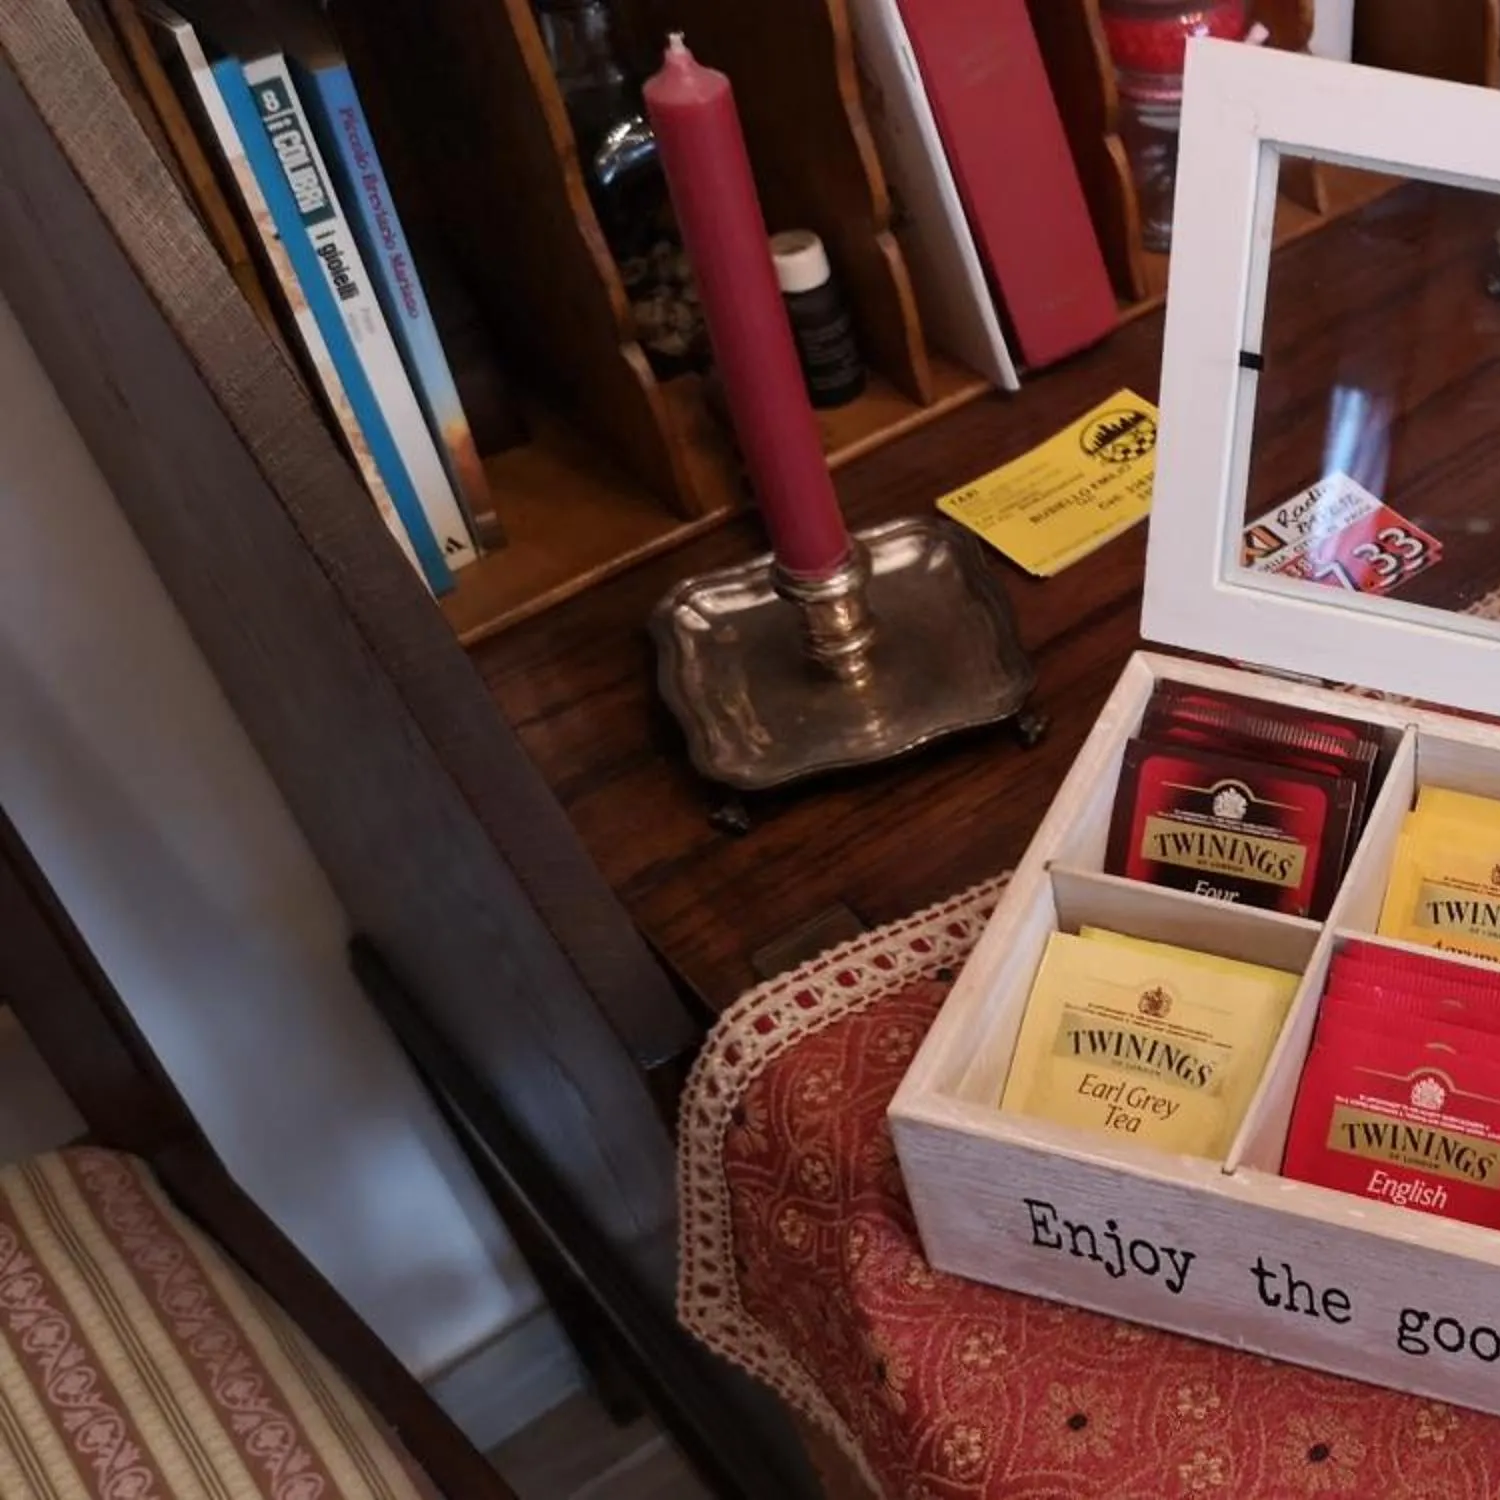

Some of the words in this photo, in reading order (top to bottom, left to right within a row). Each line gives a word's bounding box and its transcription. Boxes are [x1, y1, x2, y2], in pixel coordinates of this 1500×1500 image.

[339, 107, 368, 170] Piccolo
[362, 171, 397, 251] Breviario
[390, 251, 420, 320] Mariano
[317, 242, 360, 301] gioielli
[1154, 831, 1293, 881] TWININGS
[1067, 1028, 1213, 1088] TWININGS
[1078, 1072, 1126, 1102] Earl
[1127, 1087, 1181, 1121] Grey
[1104, 1104, 1142, 1133] Tea
[1341, 1120, 1496, 1182] TWININGS
[1367, 1169, 1448, 1210] English
[1022, 1198, 1197, 1295] Enjoy
[1252, 1256, 1352, 1324] the
